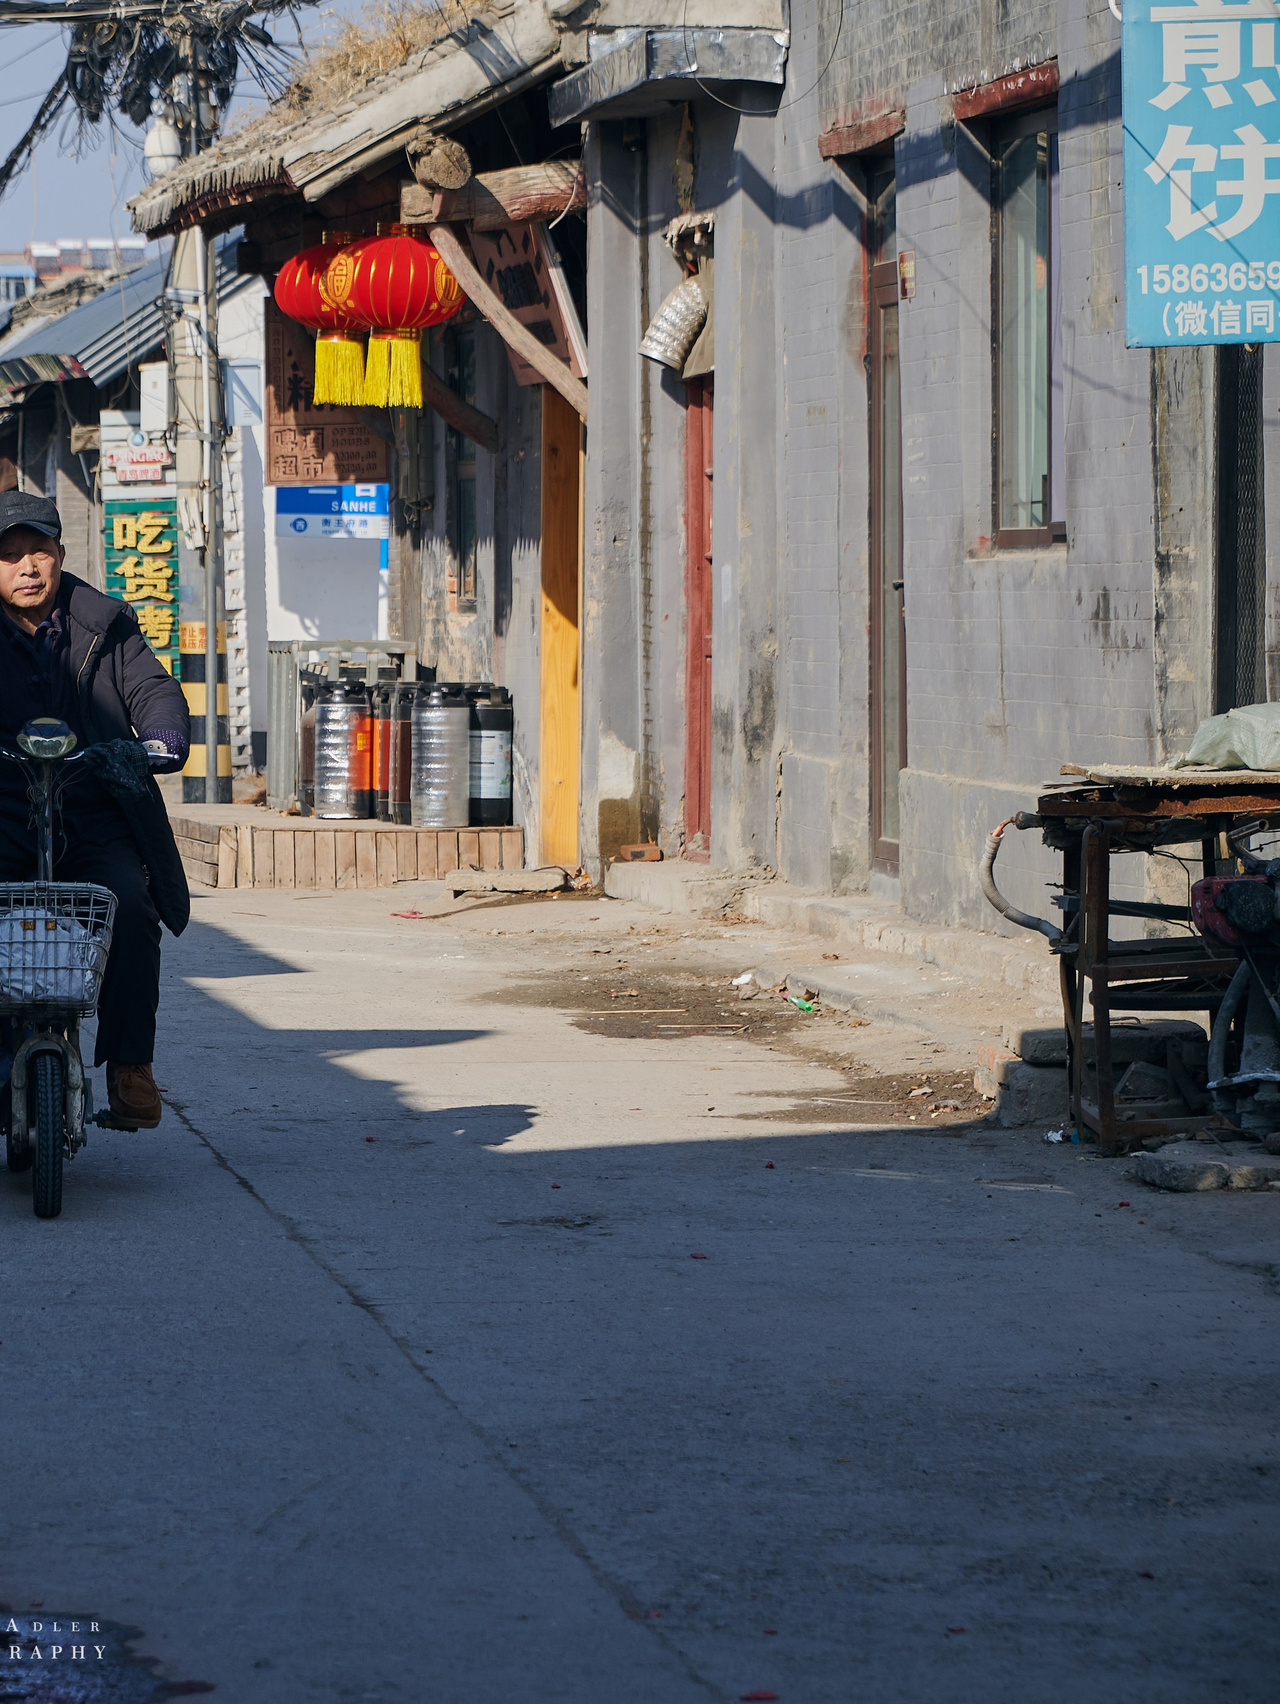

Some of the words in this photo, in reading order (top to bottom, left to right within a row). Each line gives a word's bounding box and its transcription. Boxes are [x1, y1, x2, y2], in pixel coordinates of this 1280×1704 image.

[1137, 261, 1280, 295] 15863659
[1163, 299, 1280, 337] (微信同
[274, 428, 324, 452] 啤酒
[331, 437, 370, 447] HOURS
[274, 455, 324, 478] 超市
[331, 500, 377, 513] SANHE
